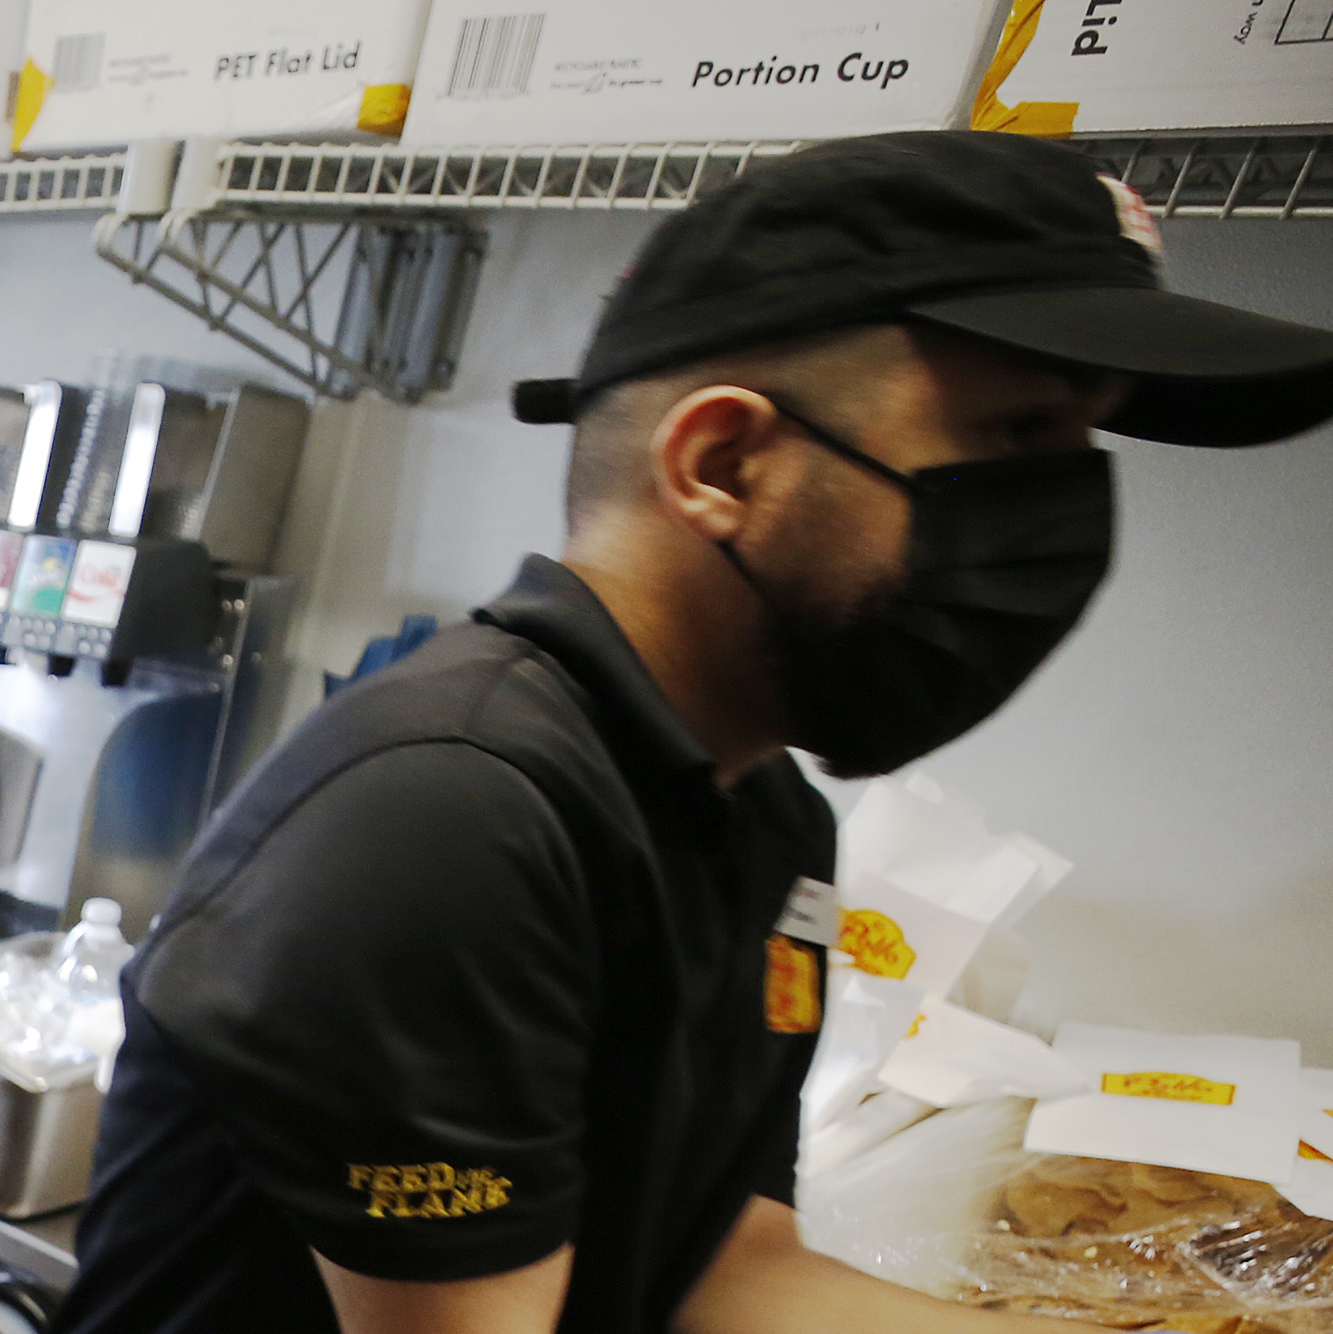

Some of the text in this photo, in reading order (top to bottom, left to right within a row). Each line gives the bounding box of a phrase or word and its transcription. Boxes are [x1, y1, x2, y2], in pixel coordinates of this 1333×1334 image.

[215, 54, 257, 79] PET
[265, 49, 312, 76] Flat
[323, 40, 362, 70] Lid
[691, 52, 909, 90] Portion Cup
[346, 1161, 457, 1192] FEED
